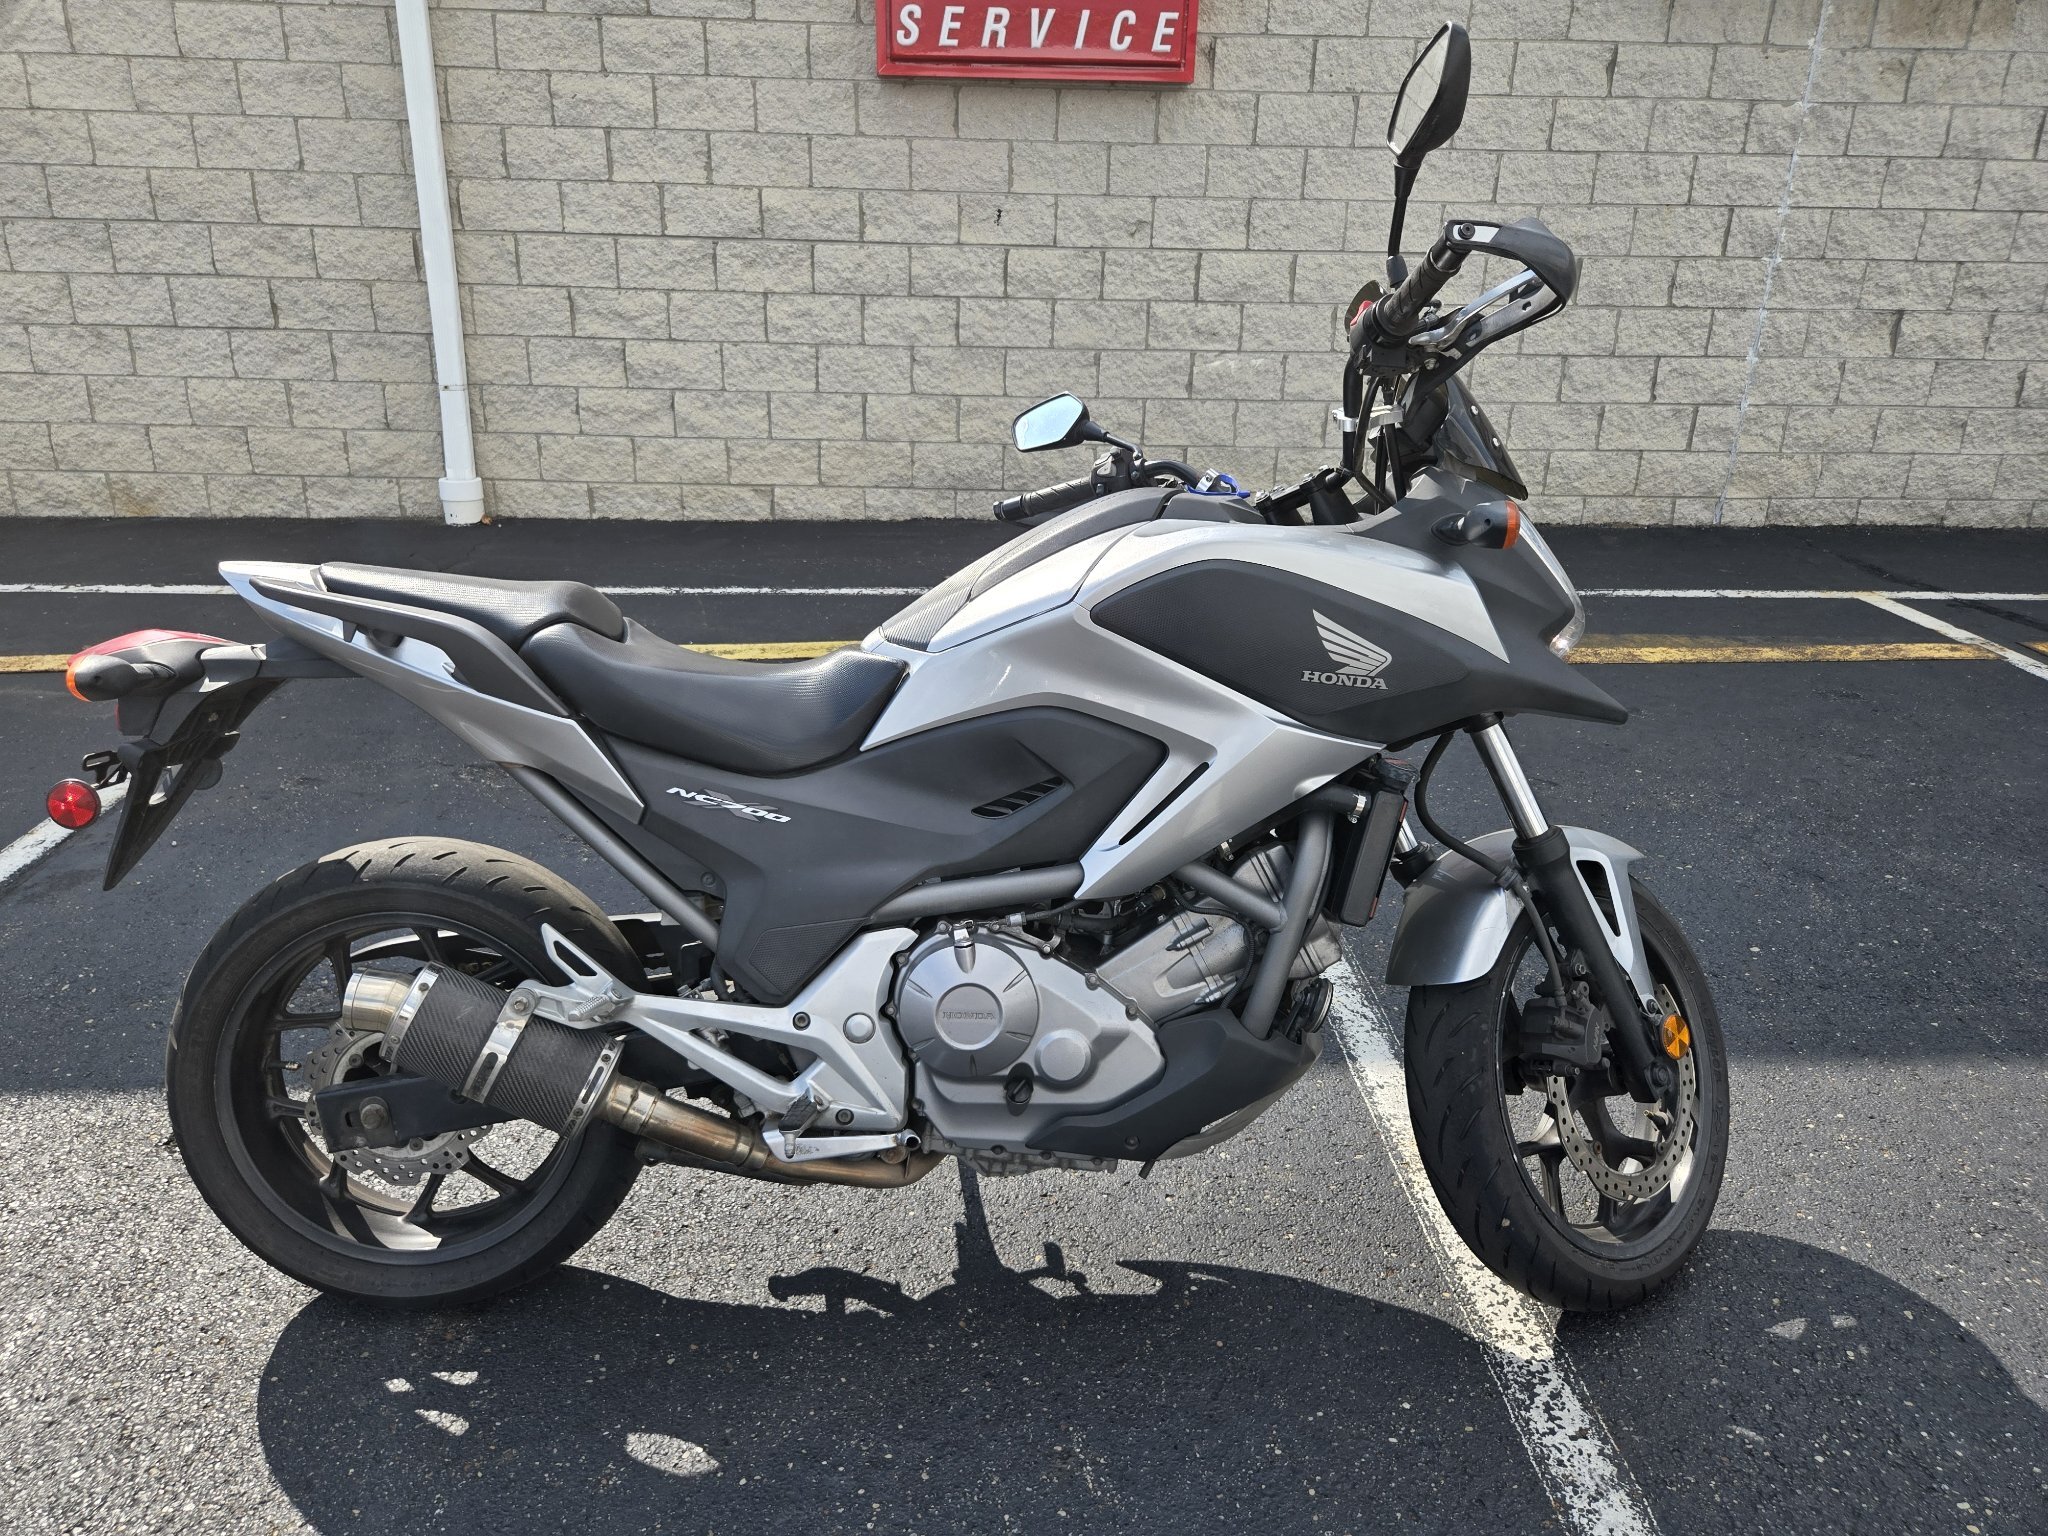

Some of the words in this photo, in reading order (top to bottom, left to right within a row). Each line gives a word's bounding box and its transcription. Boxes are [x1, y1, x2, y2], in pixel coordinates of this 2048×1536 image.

[896, 4, 1180, 53] SERVICE
[1301, 670, 1389, 690] HONDA
[666, 787, 792, 823] NC700
[942, 1010, 997, 1020] HONDA
